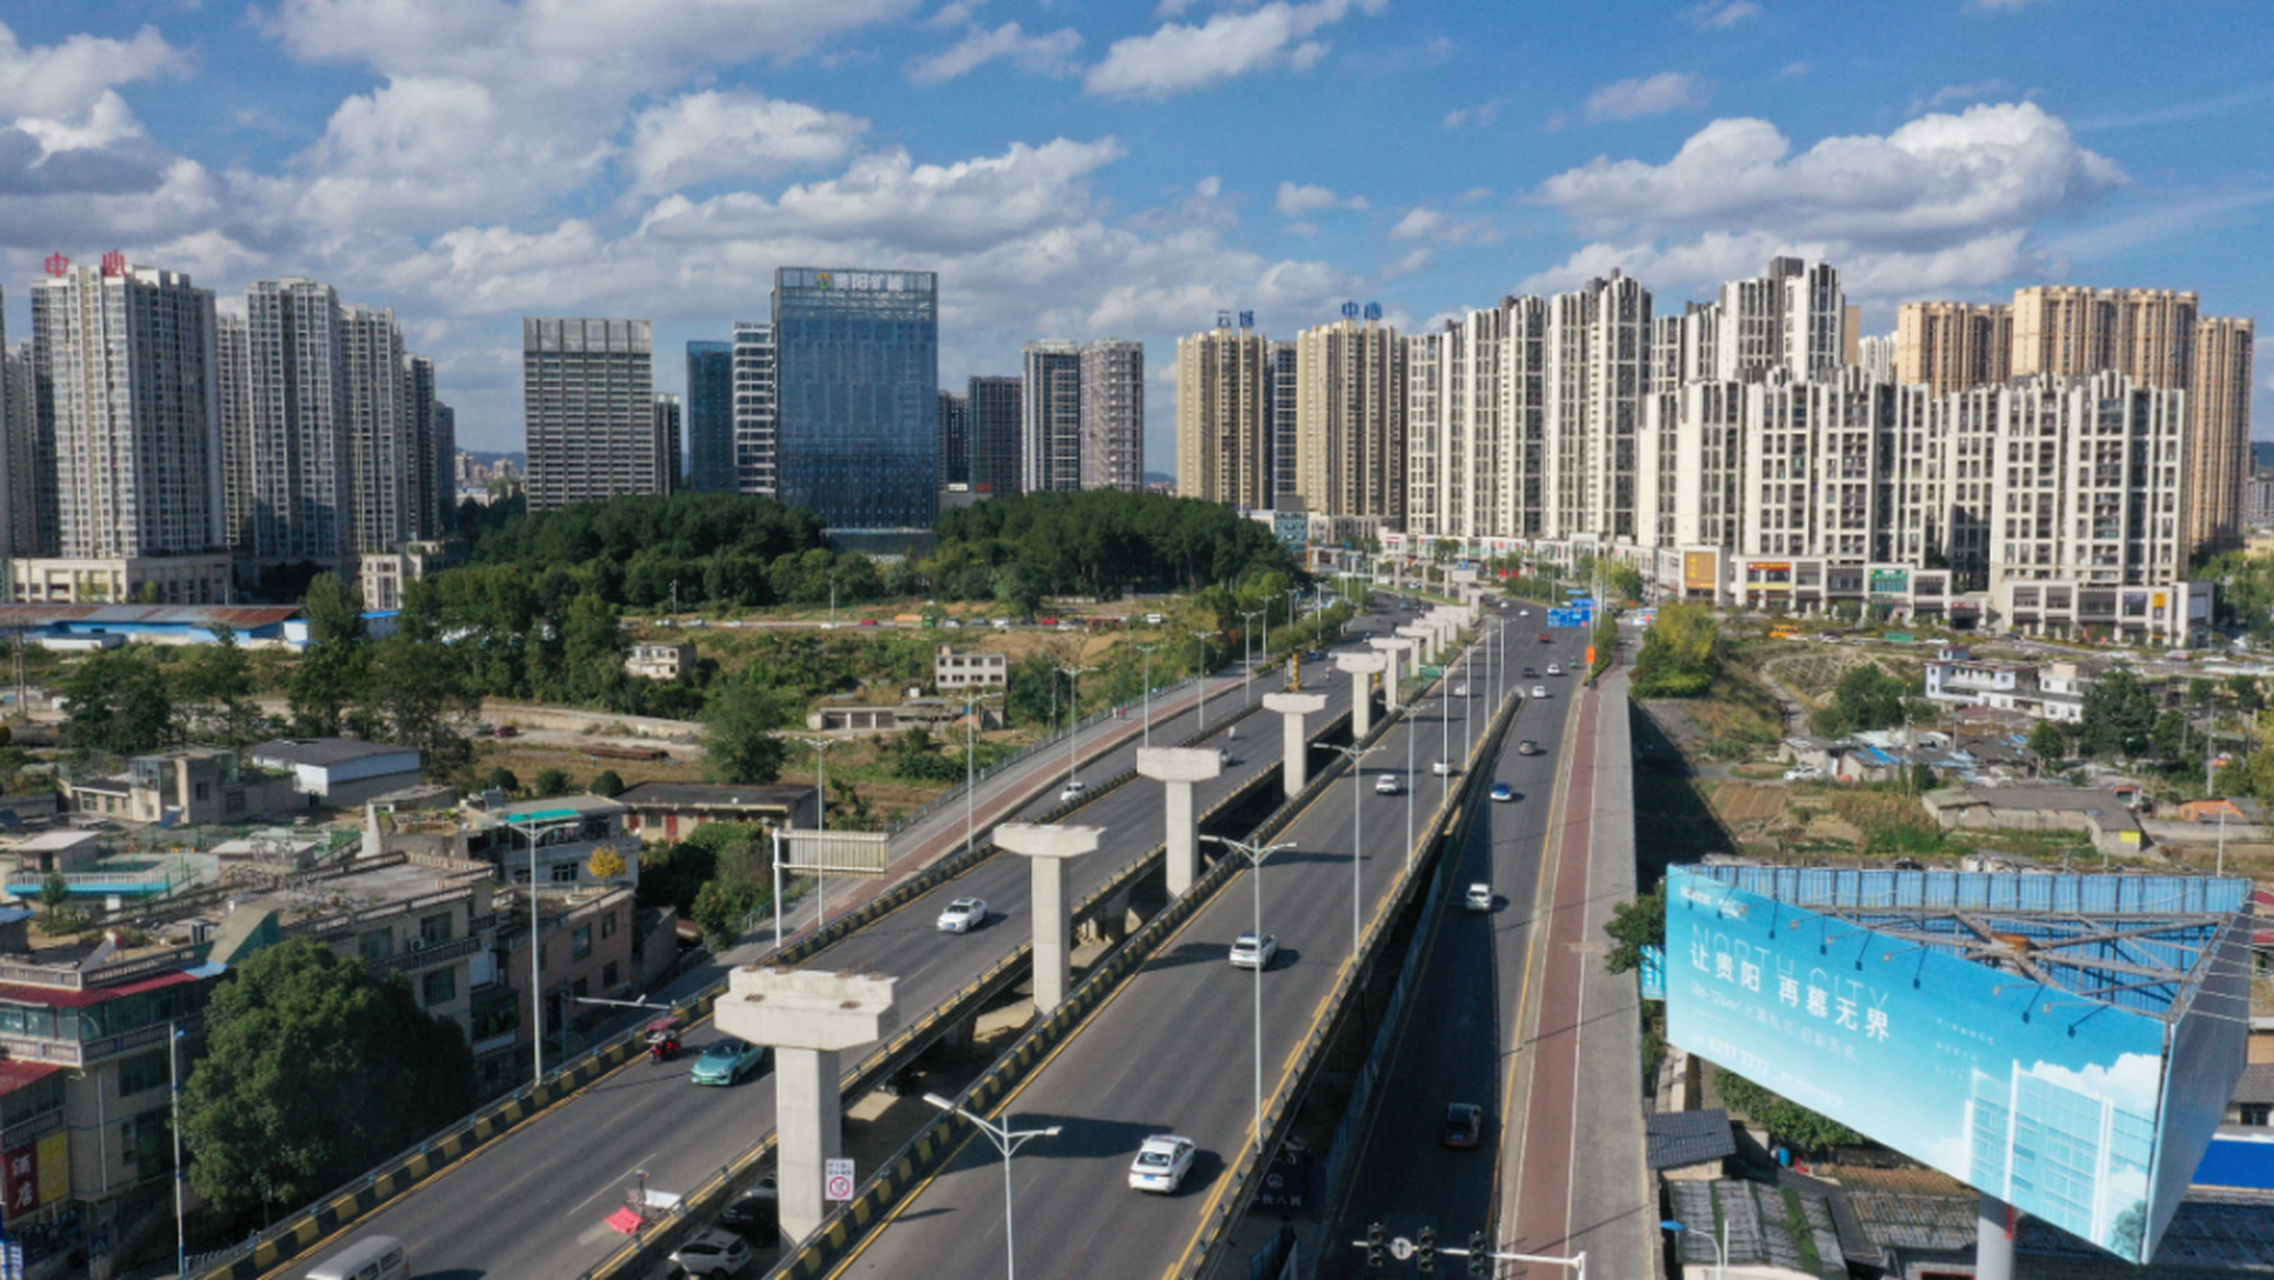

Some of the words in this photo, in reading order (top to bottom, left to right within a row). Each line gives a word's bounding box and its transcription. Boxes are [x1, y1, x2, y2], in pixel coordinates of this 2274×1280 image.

[45, 249, 127, 278] 中心
[1690, 943, 1761, 993] 让贵阳
[1692, 924, 1795, 978] NORTH
[1809, 967, 1890, 1010] CITY
[12, 1153, 34, 1209] 酒店
